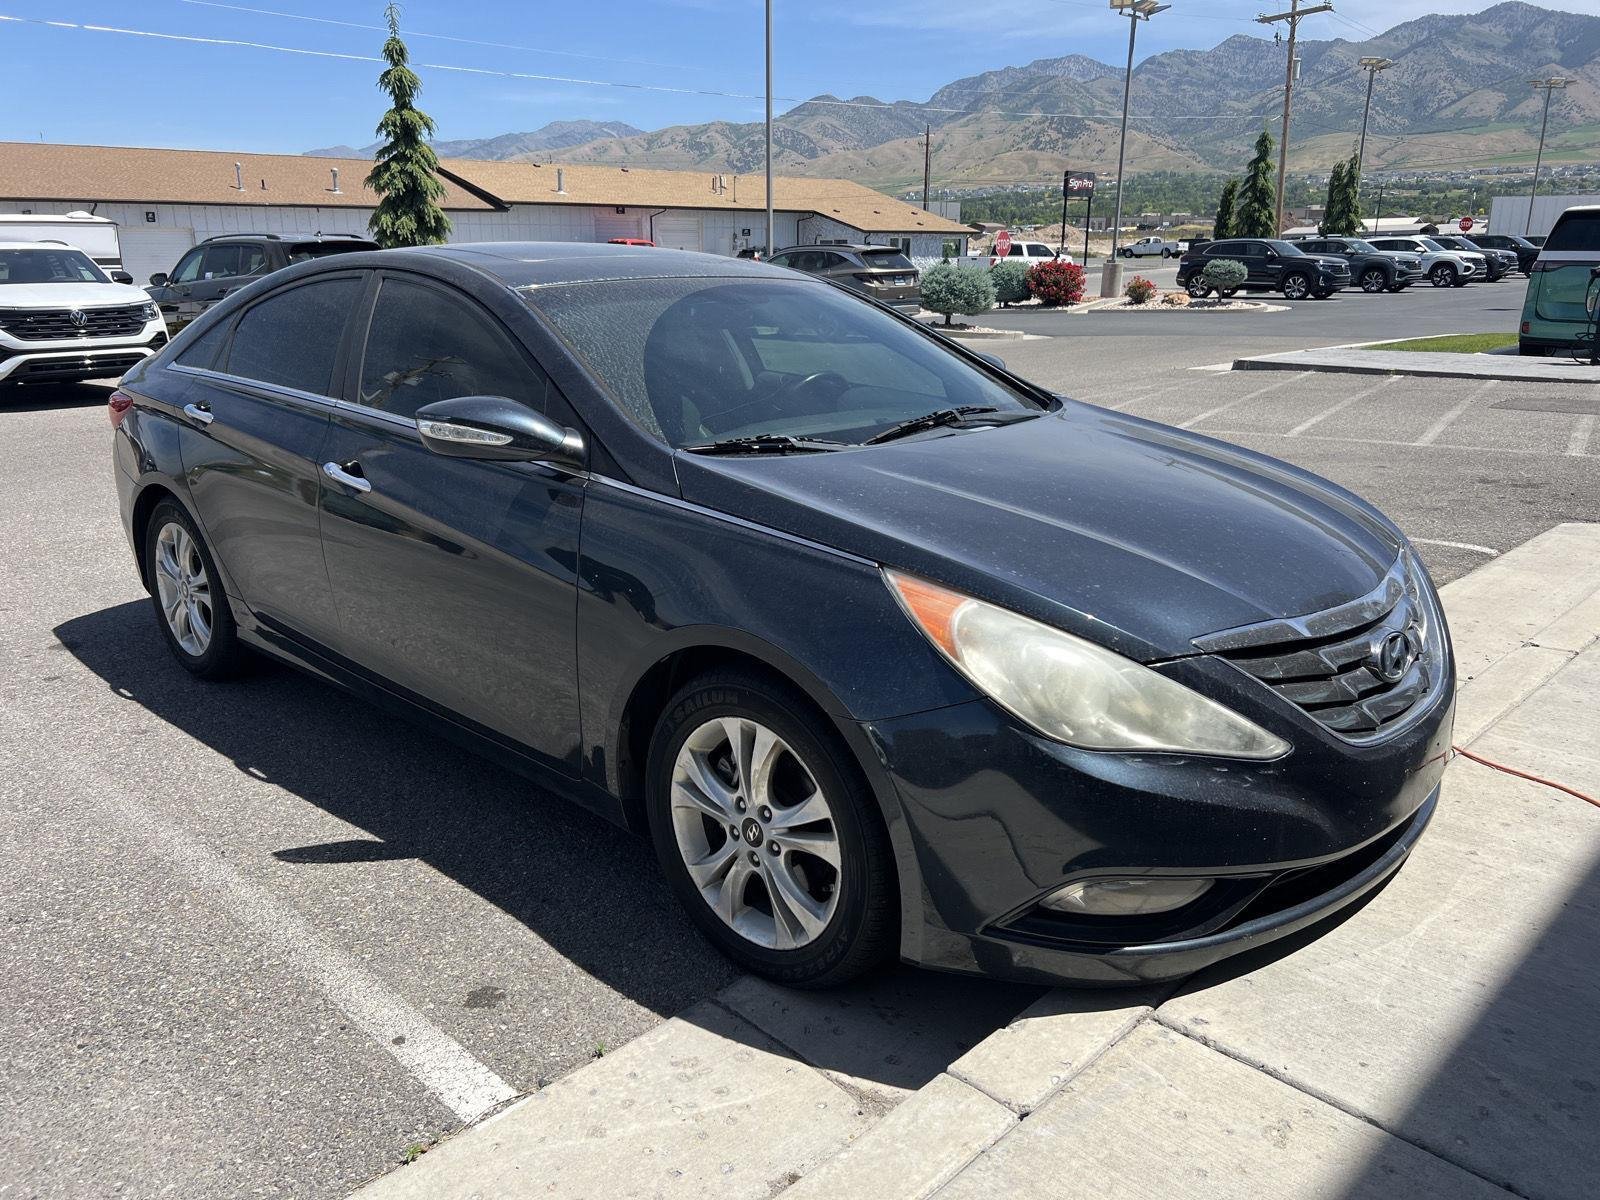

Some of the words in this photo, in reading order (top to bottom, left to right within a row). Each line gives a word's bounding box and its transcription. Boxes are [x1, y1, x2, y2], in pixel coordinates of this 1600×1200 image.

[1069, 178, 1082, 190] Sign
[1083, 179, 1094, 188] Pro
[997, 239, 1010, 250] STOP
[671, 690, 739, 722] SAILUN
